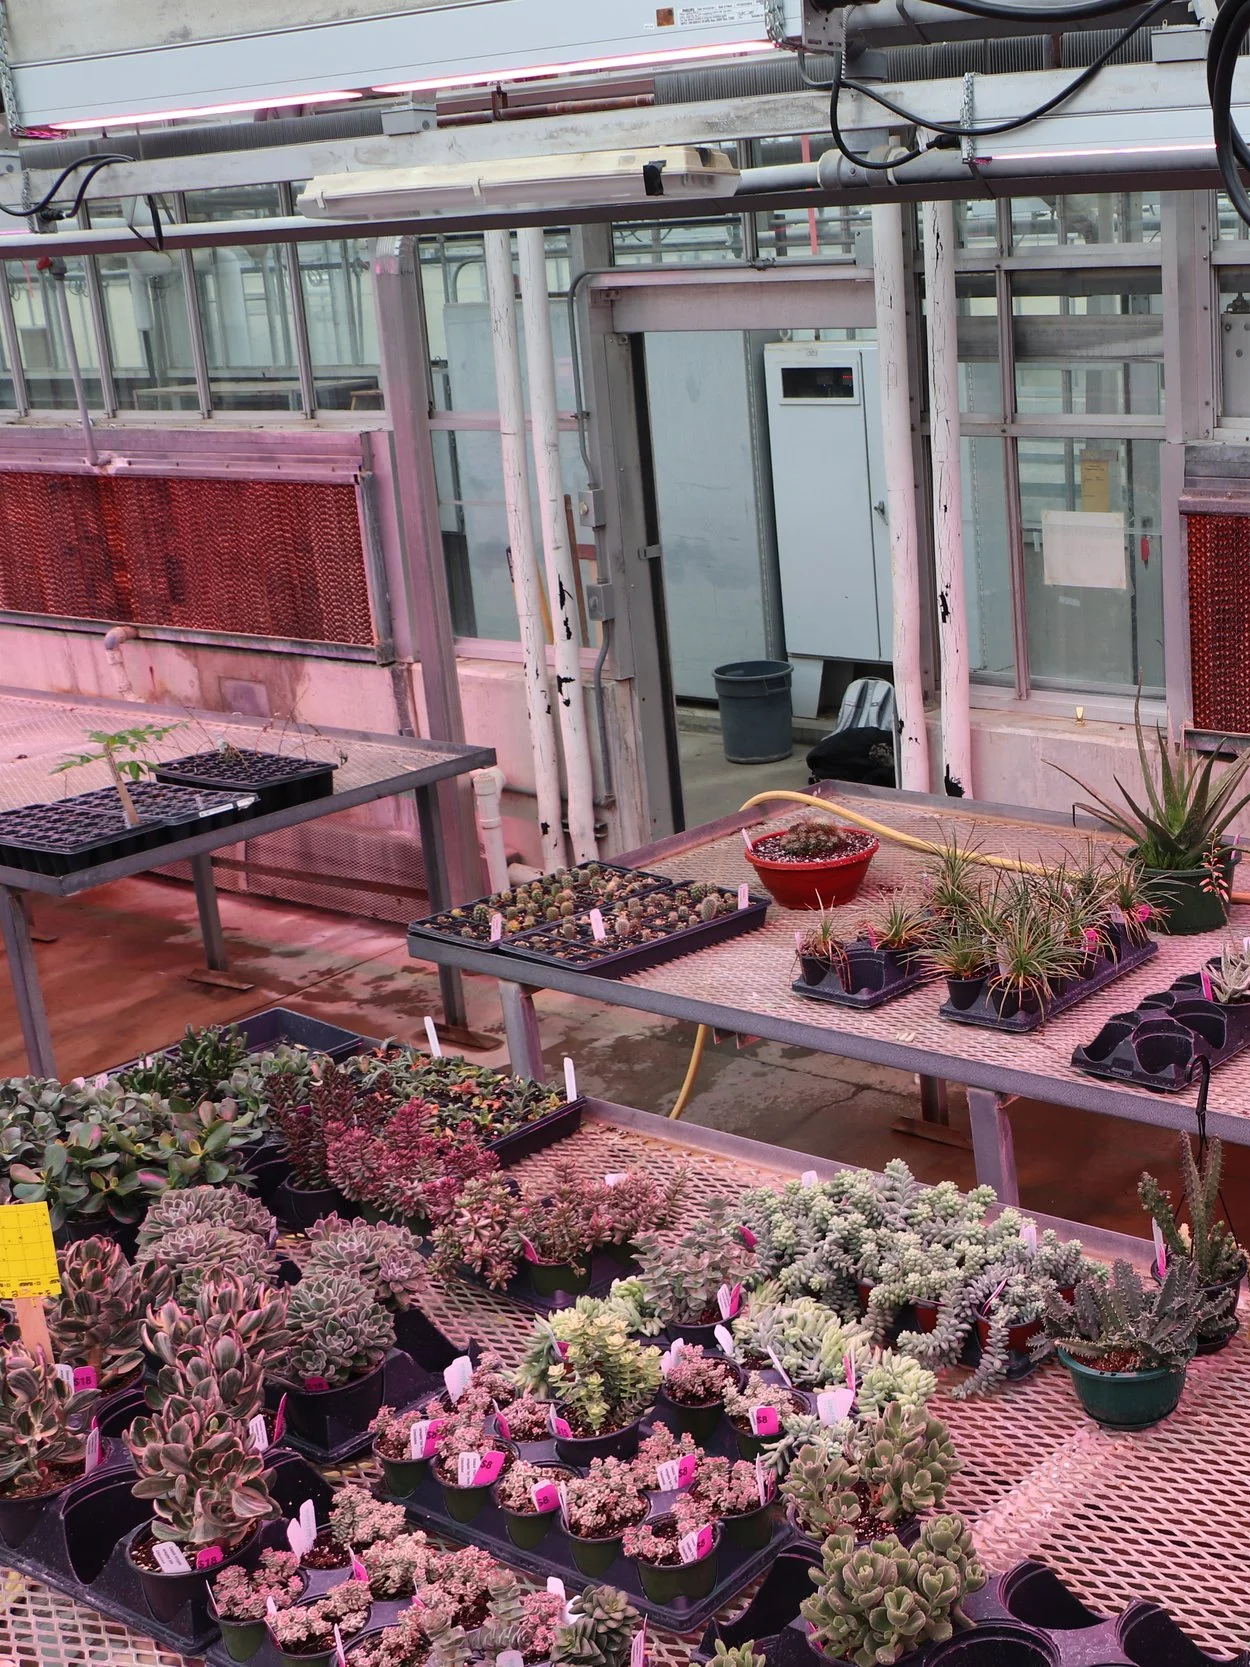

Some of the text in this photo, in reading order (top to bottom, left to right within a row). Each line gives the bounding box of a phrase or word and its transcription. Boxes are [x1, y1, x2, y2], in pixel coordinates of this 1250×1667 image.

[74, 1375, 92, 1386] $18
[756, 1416, 767, 1424] $8
[481, 1459, 492, 1469] $8
[679, 1466, 688, 1478] $8
[537, 1497, 549, 1507] $8
